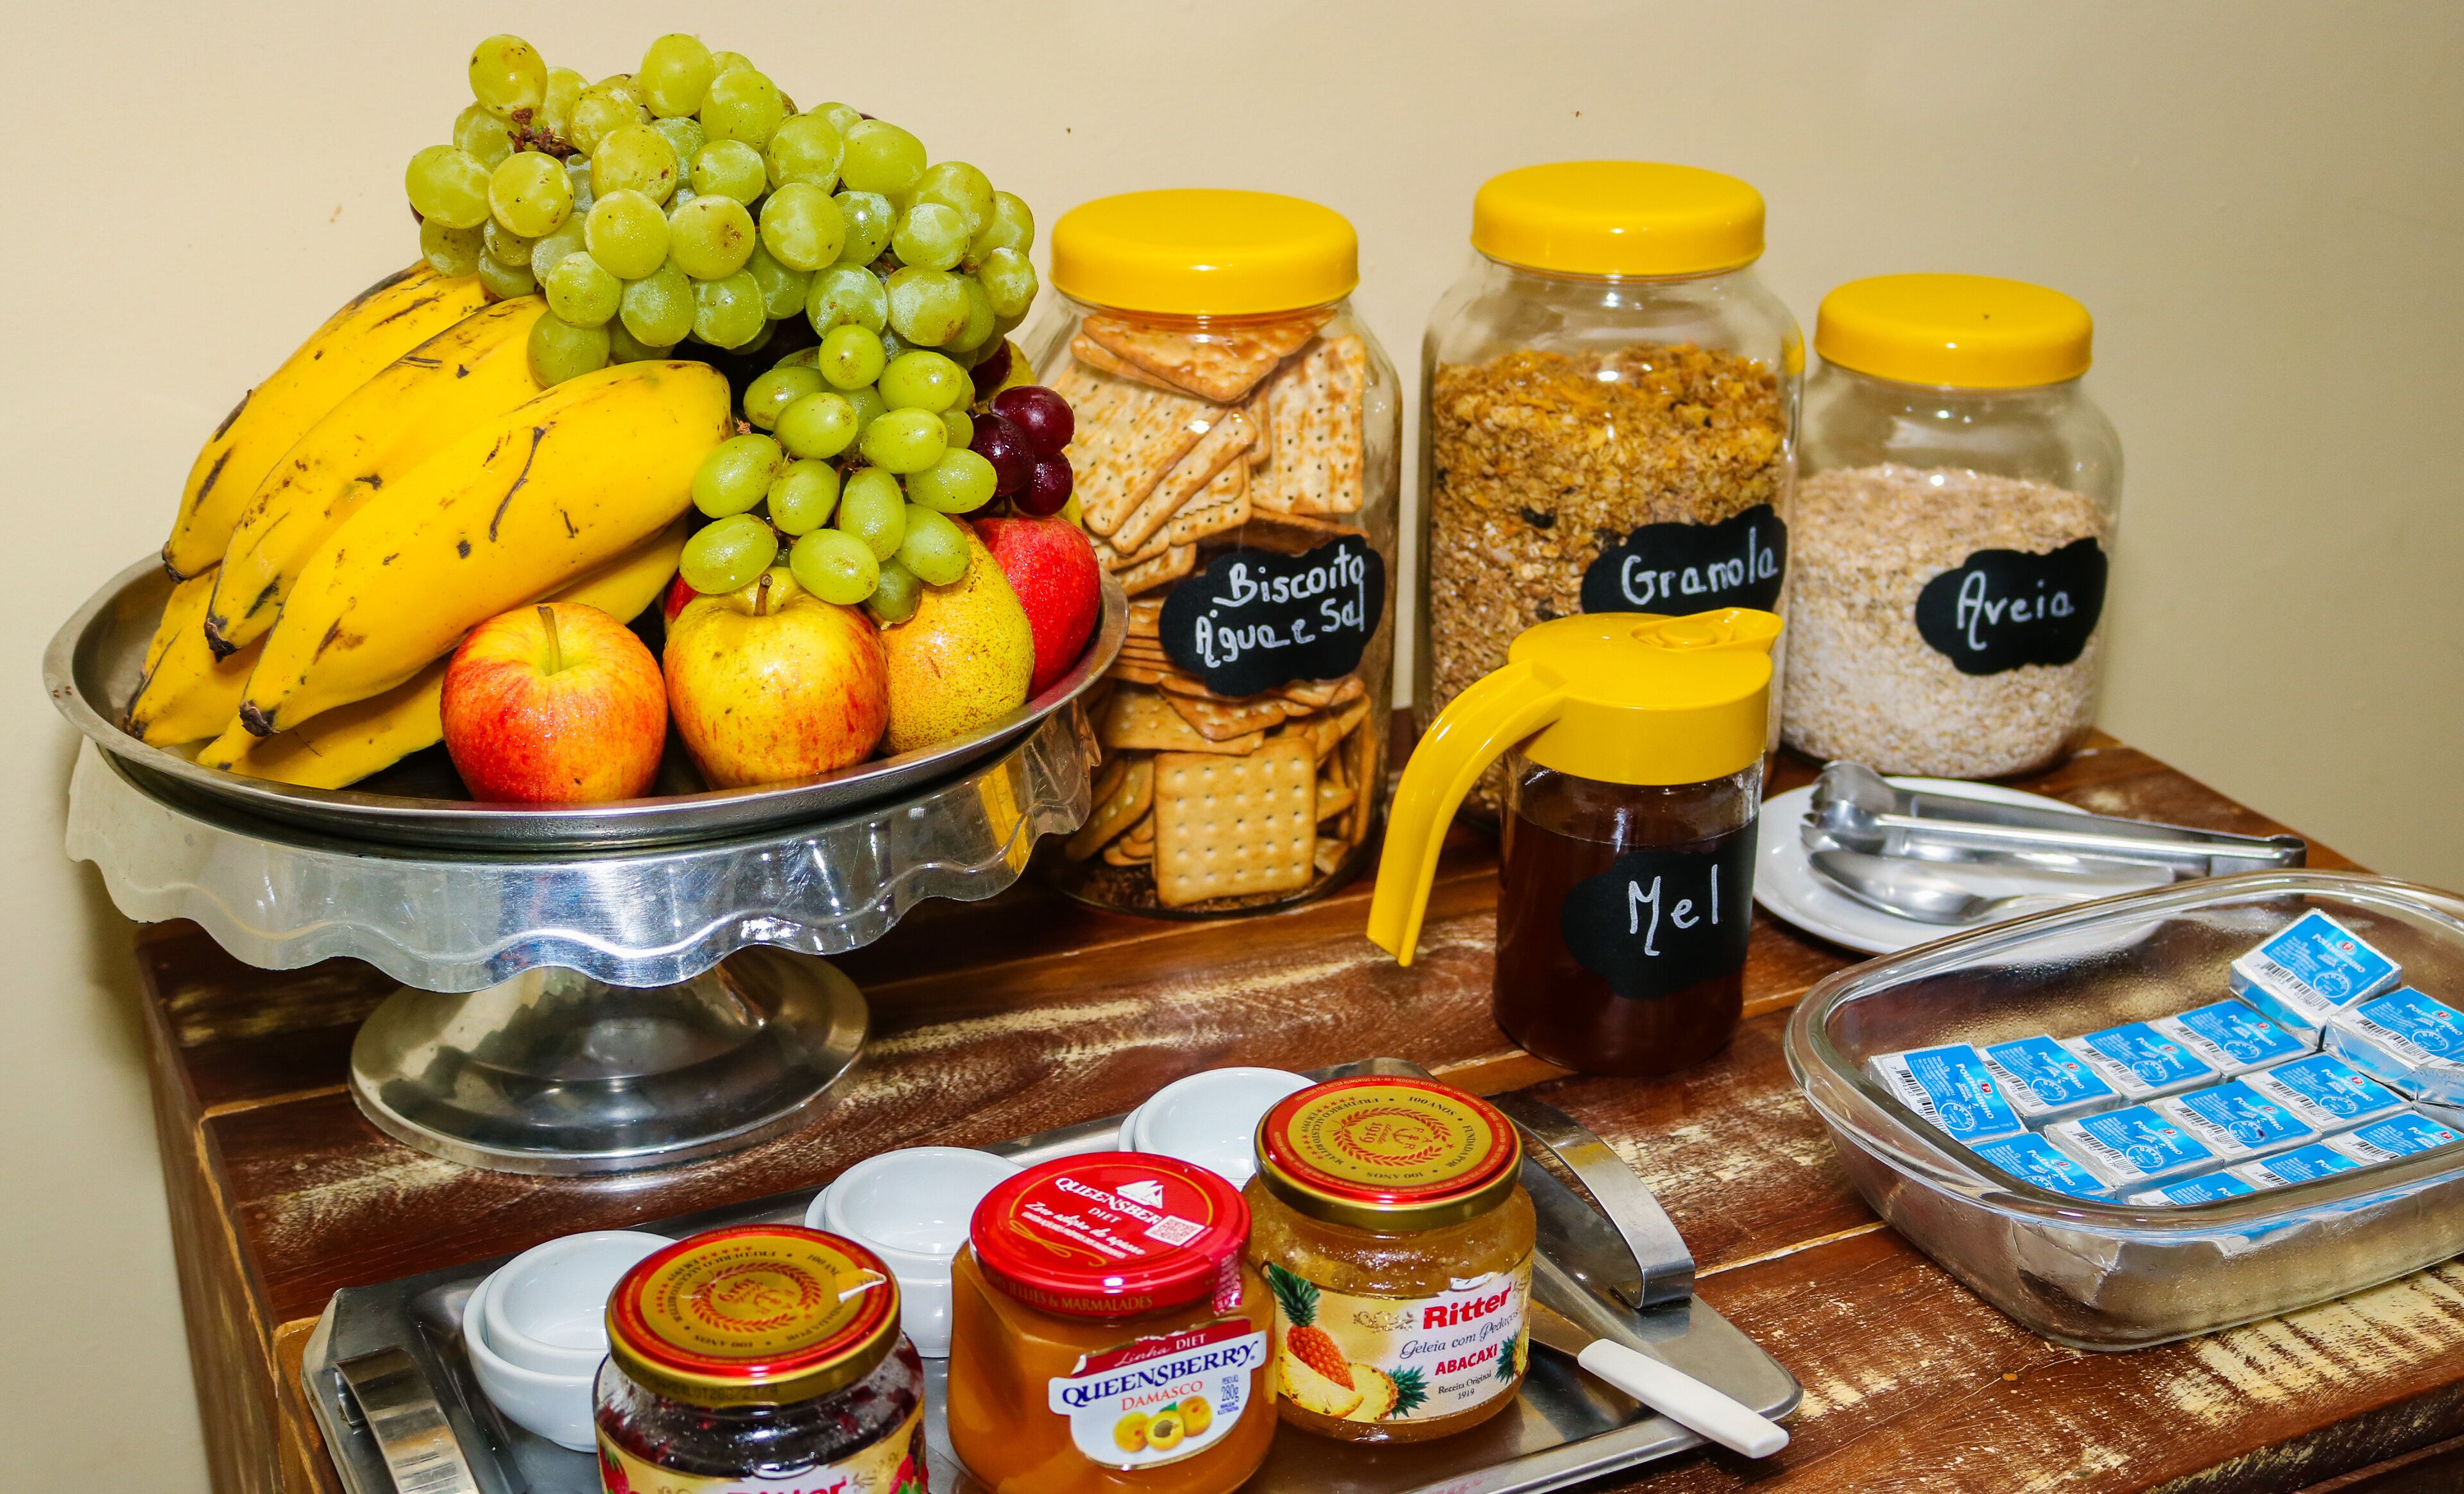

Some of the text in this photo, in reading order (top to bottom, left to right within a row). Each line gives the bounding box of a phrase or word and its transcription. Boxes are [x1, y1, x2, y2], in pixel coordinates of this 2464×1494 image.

[1213, 544, 1365, 607] Biscoito
[1621, 526, 1778, 606] Granola
[1291, 618, 1315, 644] e
[1320, 581, 1365, 632] Sal
[1957, 570, 2075, 651] Aveia
[1629, 863, 1718, 956] Mel
[1898, 1078, 1915, 1098] 891143
[1955, 1063, 1995, 1119] POLENGUINHO
[1323, 1098, 1380, 1118] FREDERICO
[1408, 1096, 1457, 1117] 100 ANOS
[1358, 1122, 1383, 1144] 1919
[1445, 1125, 1475, 1168] FUNDADA POR
[2027, 1149, 2076, 1187] POLENGUINHO
[1055, 1177, 1163, 1225] QUEENSBER
[1088, 1207, 1122, 1224] DIET
[1048, 1294, 1059, 1307] &
[1061, 1294, 1153, 1312] MARMALADES
[1423, 1282, 1512, 1330] Ritter
[1114, 1333, 1206, 1368] Linha DIET
[1399, 1308, 1519, 1360] Geleia com Pedaços
[1063, 1341, 1259, 1407] QUEENSBERRY
[1435, 1343, 1498, 1376] ABACAXI
[1122, 1380, 1204, 1411] DAMASCO
[1221, 1384, 1240, 1403] 280g
[1438, 1370, 1492, 1395] Receita Original
[1457, 1388, 1475, 1400] 1919
